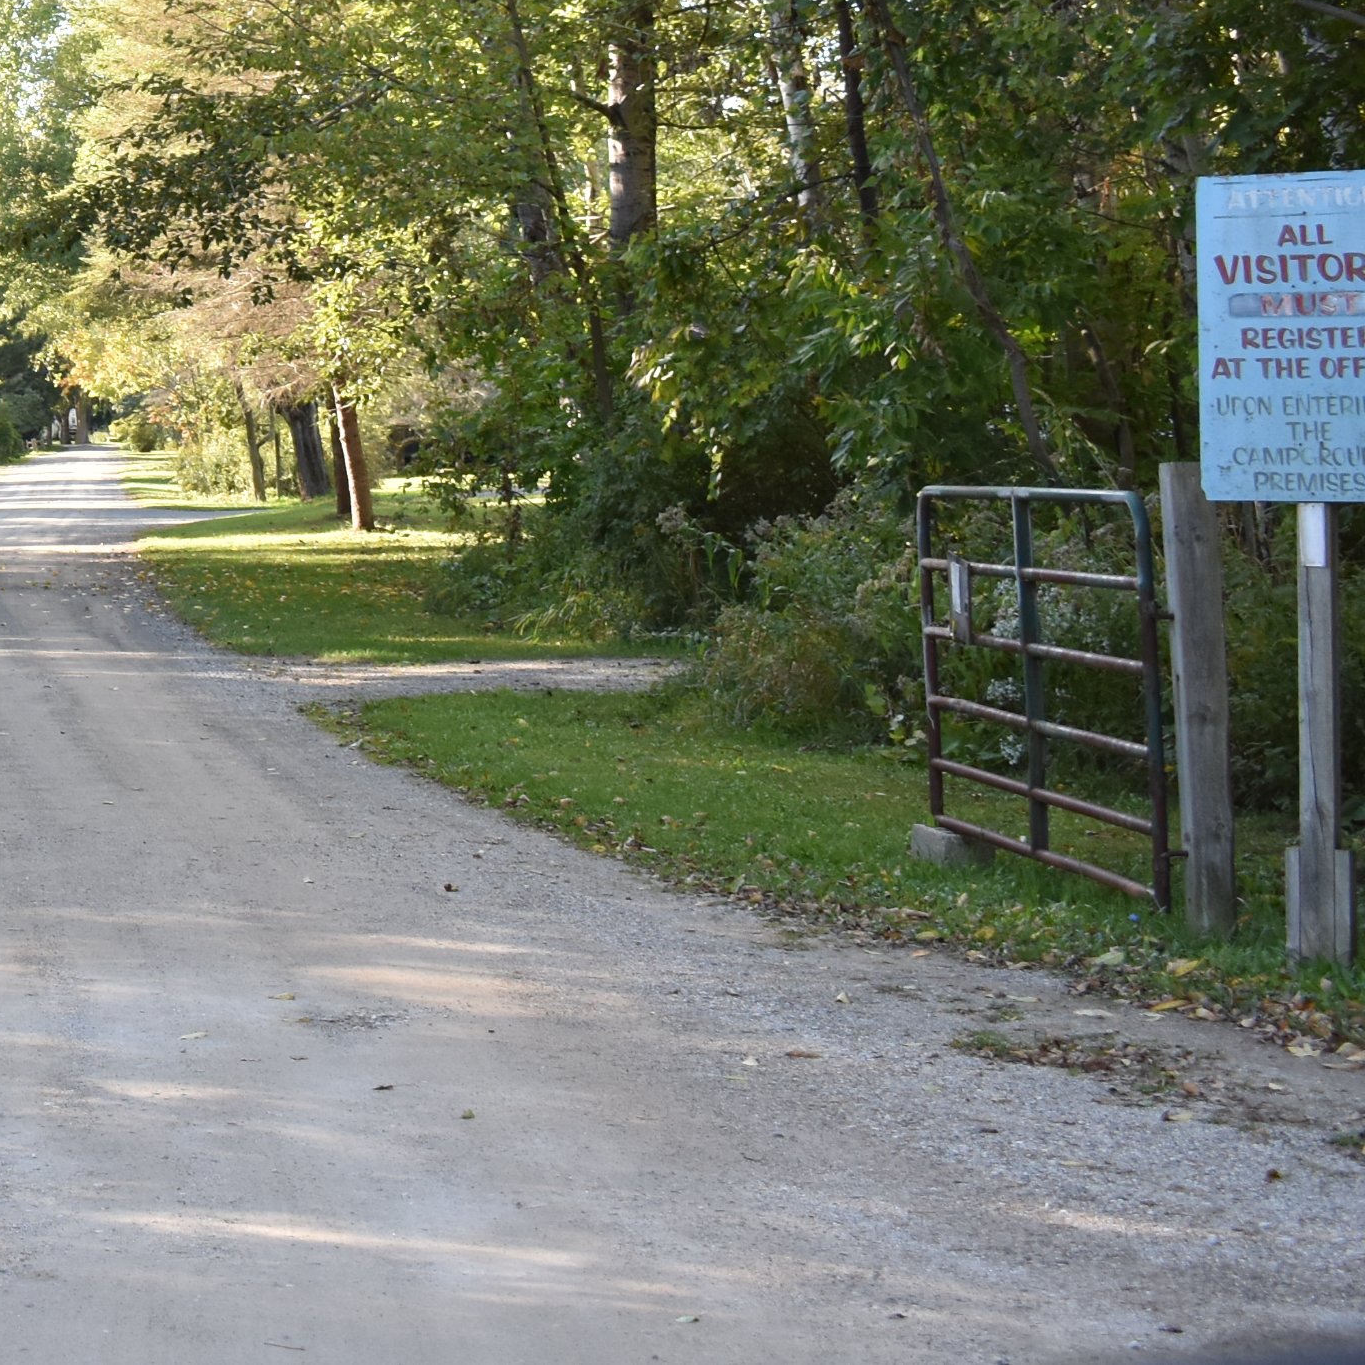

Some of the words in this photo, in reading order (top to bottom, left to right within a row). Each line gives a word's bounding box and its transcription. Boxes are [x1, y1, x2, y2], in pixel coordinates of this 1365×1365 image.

[1228, 185, 1365, 210] ATTENTIO
[1277, 223, 1333, 248] ALL
[1213, 252, 1365, 285] VISITOR
[1260, 292, 1362, 316] MUST
[1211, 356, 1246, 380] AT
[1255, 357, 1312, 380] THE
[1319, 356, 1365, 379] OFF
[1216, 395, 1273, 417] UPON
[1281, 394, 1365, 417] ENTERI
[1285, 420, 1332, 442] THE
[1232, 445, 1365, 467] CAMPGROU
[1253, 471, 1365, 492] PREMISES
